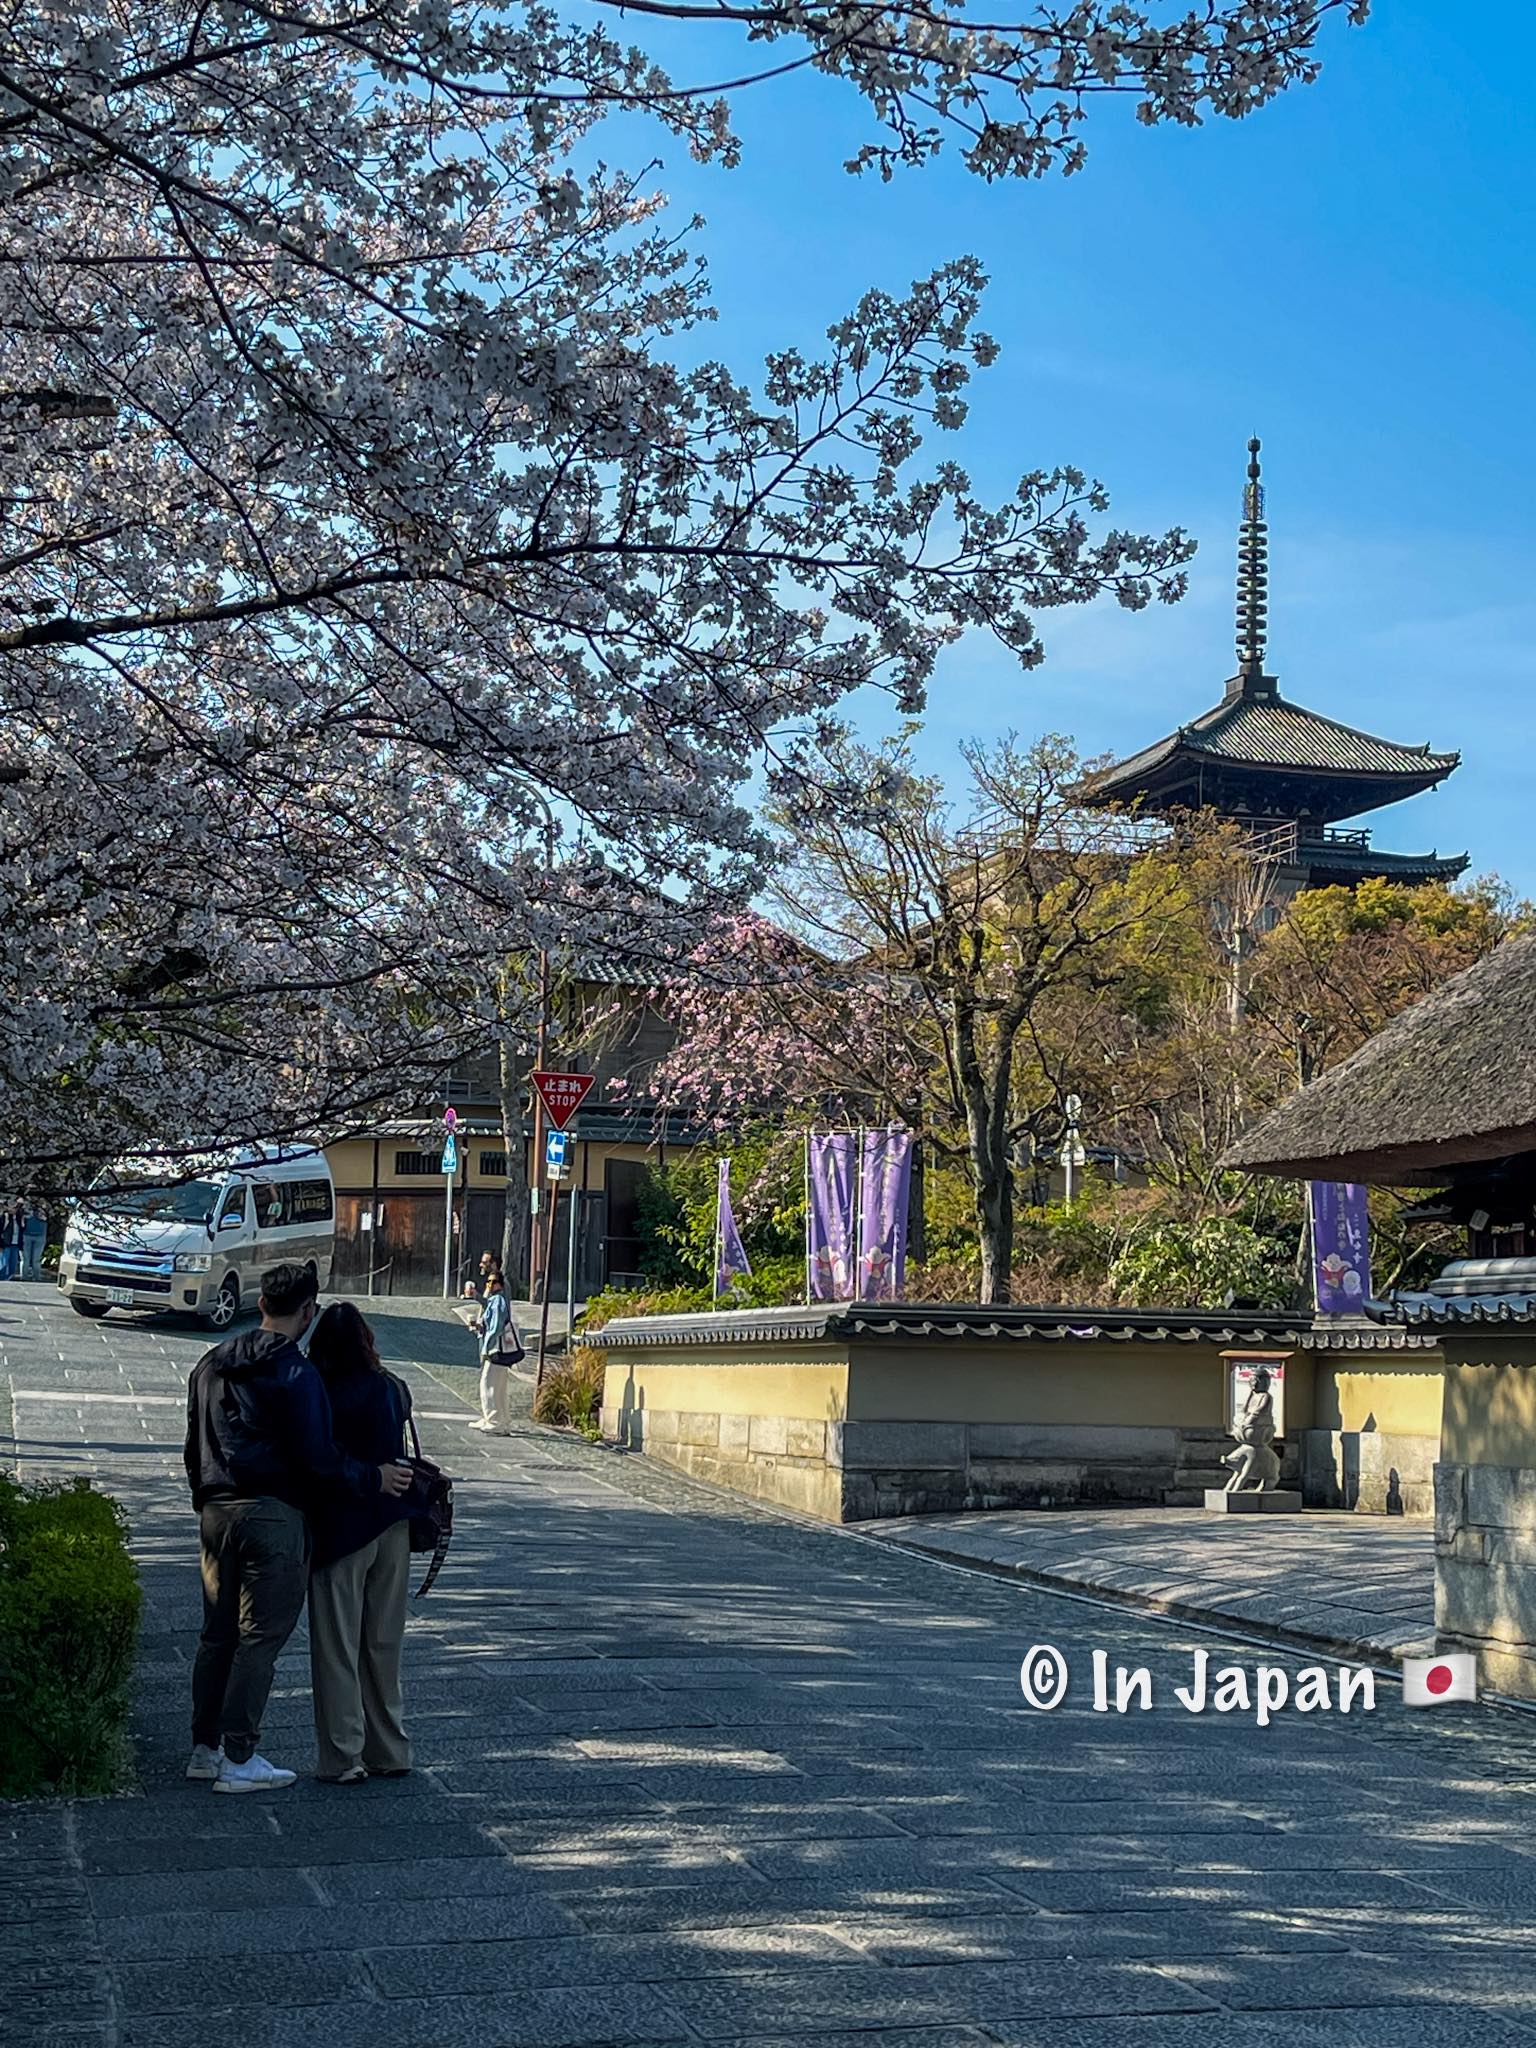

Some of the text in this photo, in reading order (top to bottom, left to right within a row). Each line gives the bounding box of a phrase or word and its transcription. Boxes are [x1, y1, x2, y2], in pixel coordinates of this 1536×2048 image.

[543, 1078, 582, 1093] 止まれ
[549, 1094, 577, 1107] STOP
